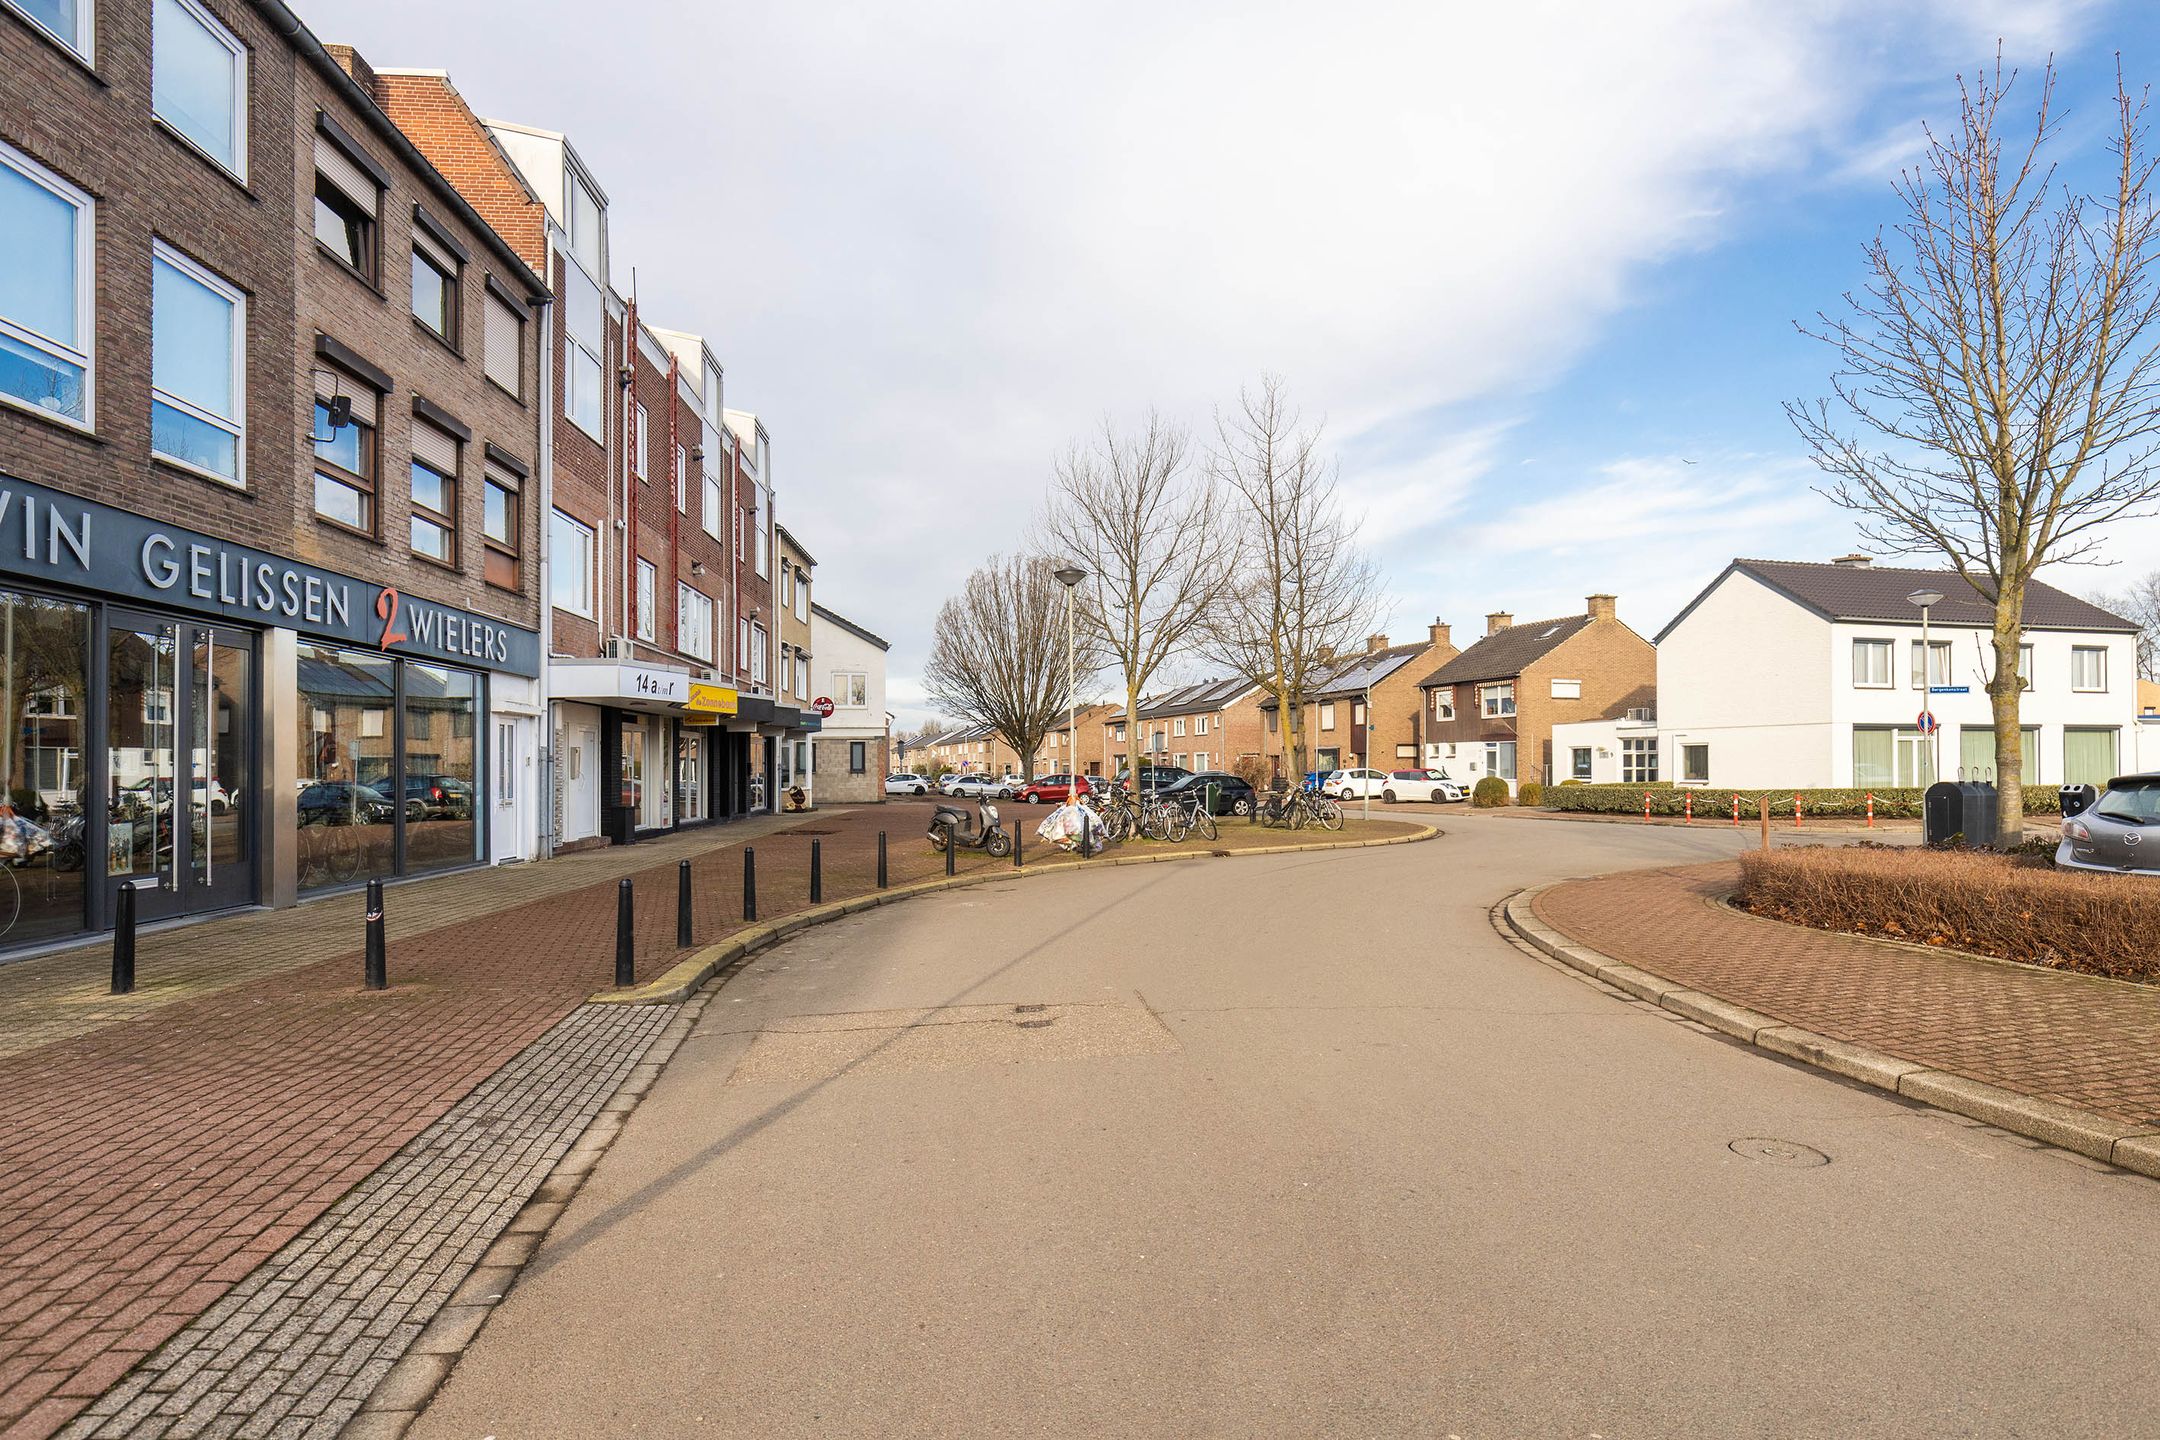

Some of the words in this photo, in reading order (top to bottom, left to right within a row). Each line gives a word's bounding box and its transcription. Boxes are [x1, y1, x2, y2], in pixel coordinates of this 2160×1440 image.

[0, 490, 91, 572] IN
[142, 533, 349, 628] GELISSEN
[377, 587, 407, 651] 2
[409, 604, 507, 662] WIELERS
[636, 673, 649, 693] 14
